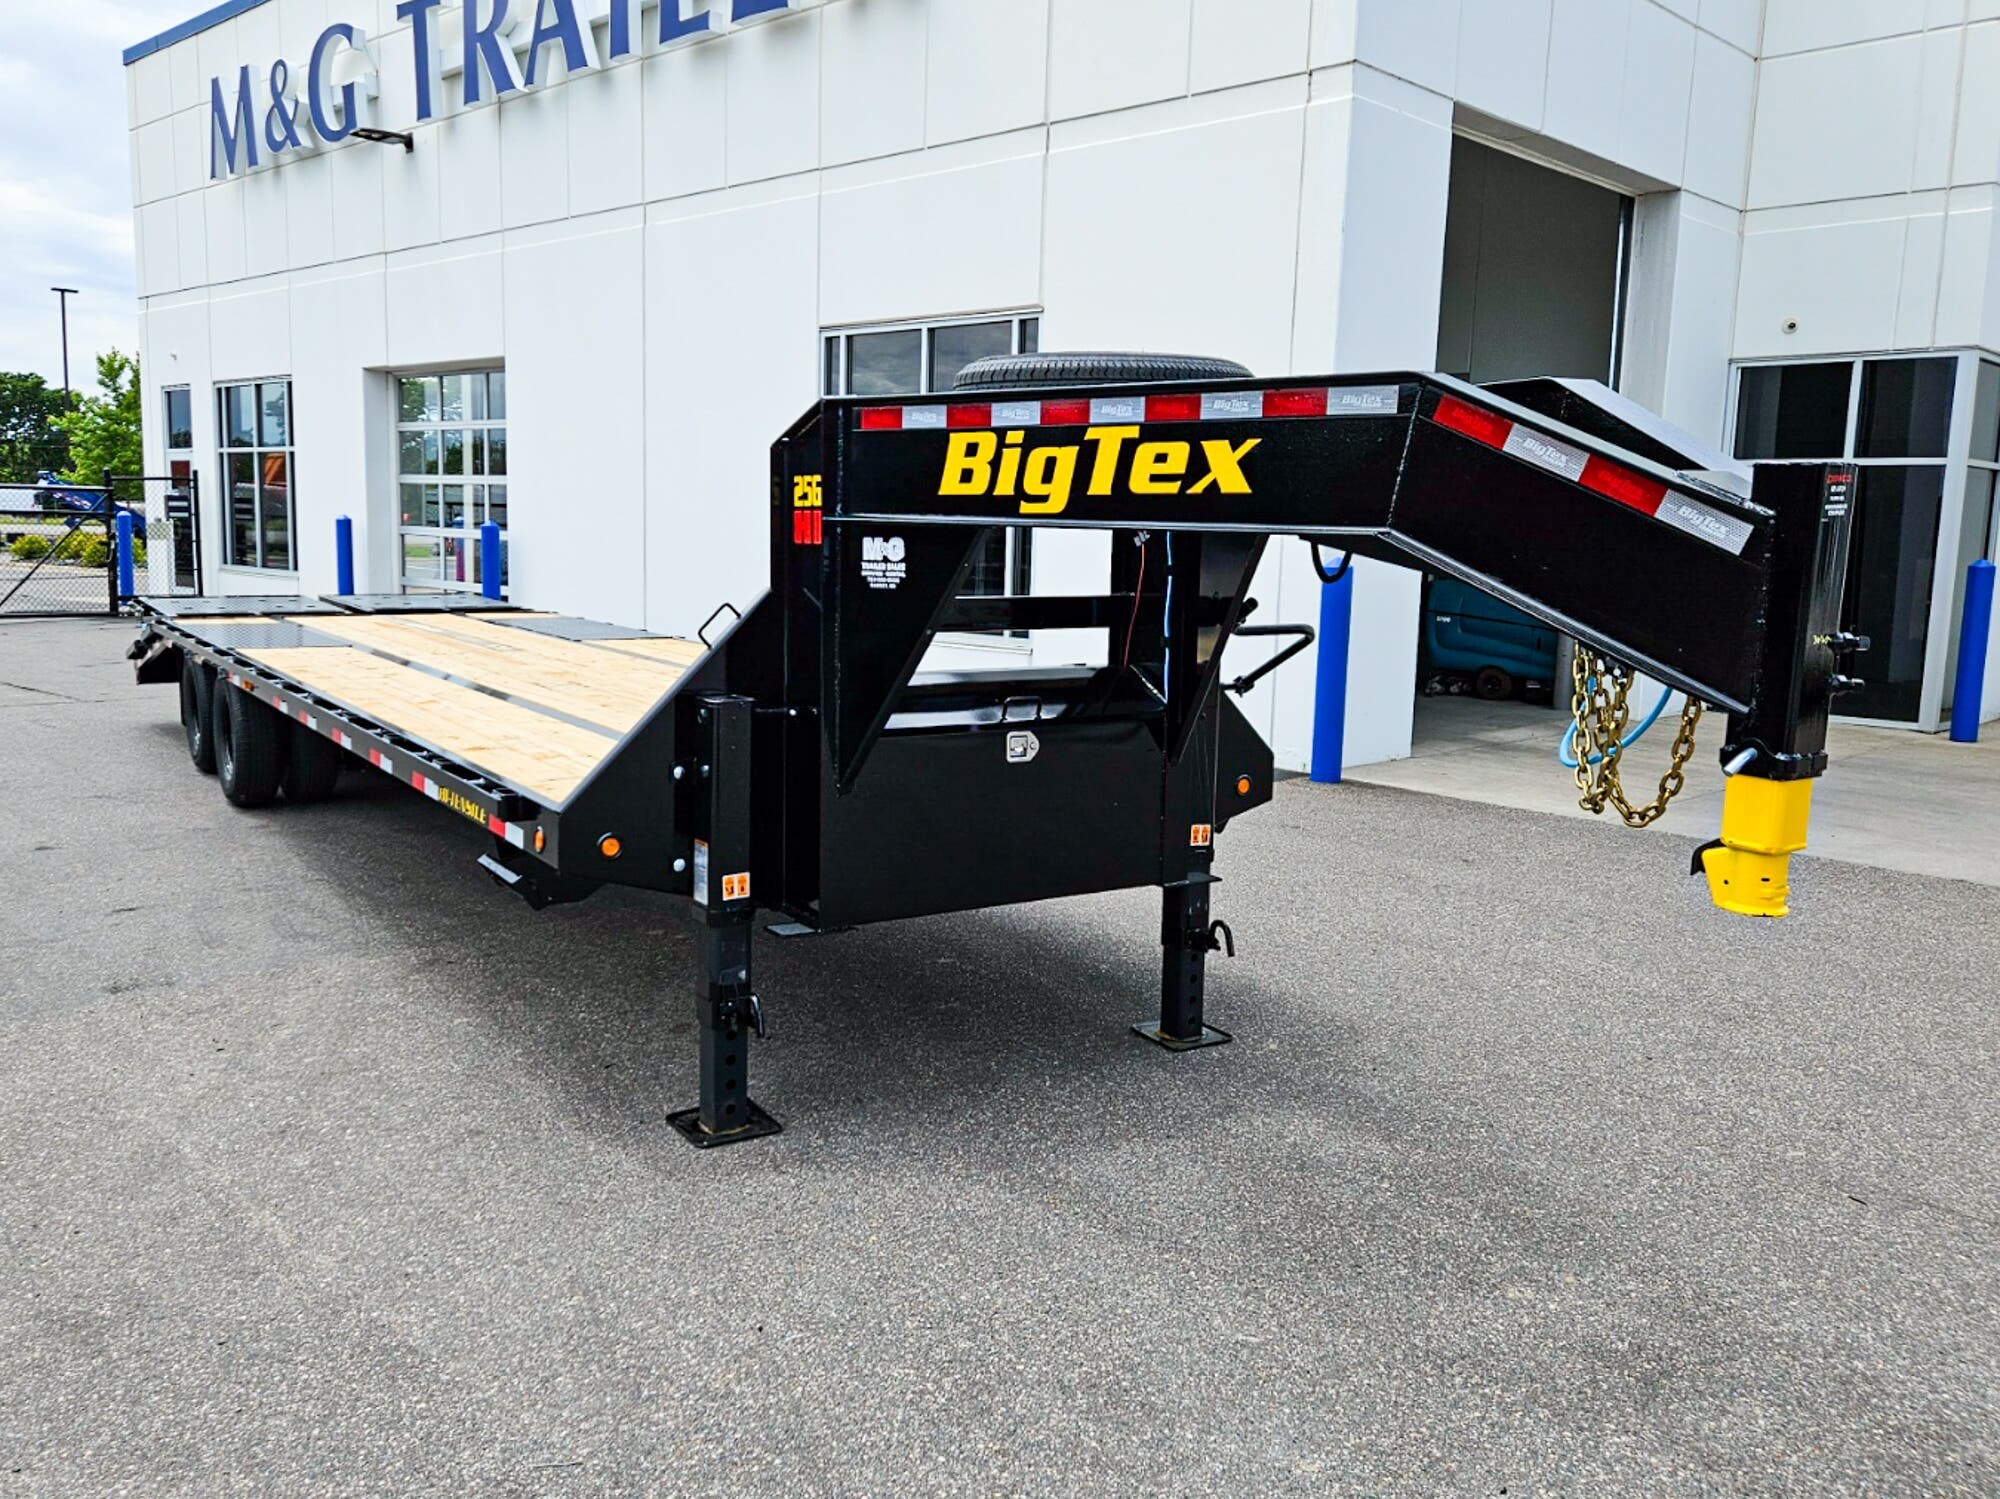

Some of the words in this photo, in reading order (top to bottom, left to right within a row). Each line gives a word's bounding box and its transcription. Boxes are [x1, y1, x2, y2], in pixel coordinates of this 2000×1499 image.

[210, 23, 358, 179] M&G
[397, 0, 788, 121] TRA
[937, 424, 1261, 514] BigTex
